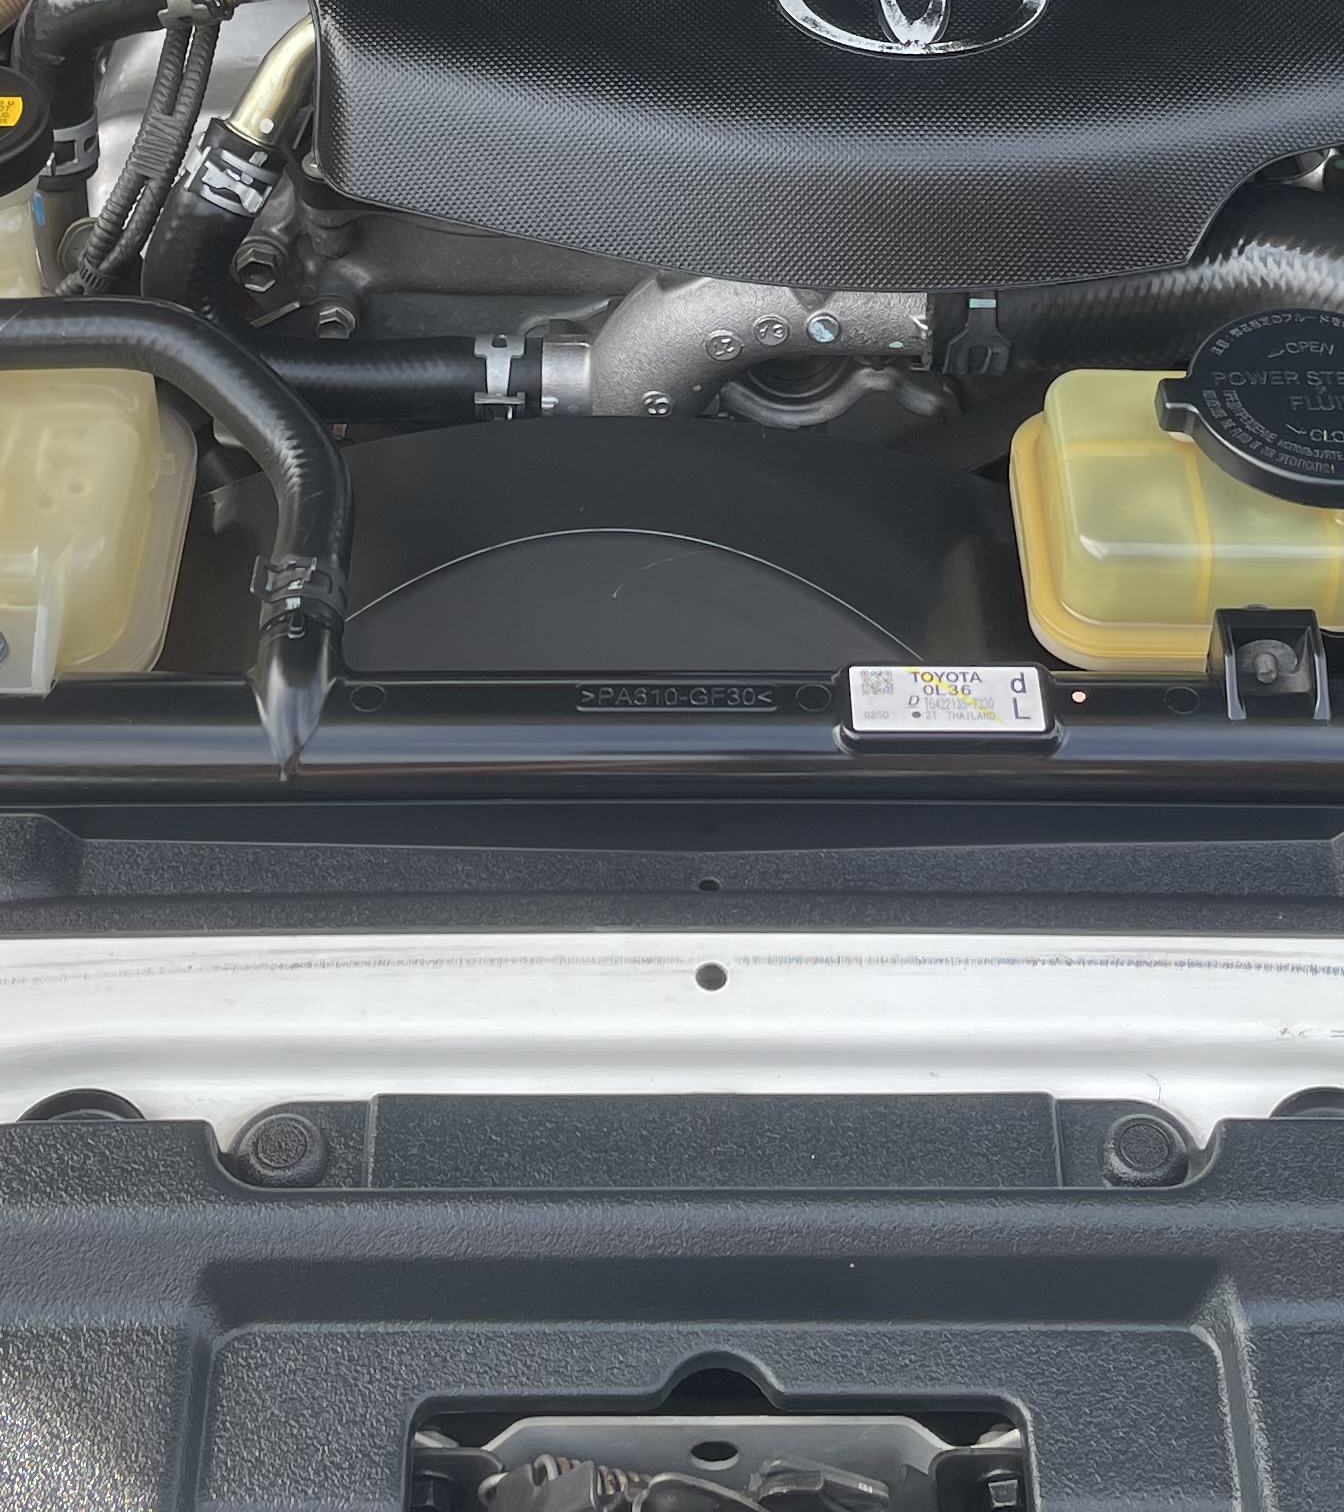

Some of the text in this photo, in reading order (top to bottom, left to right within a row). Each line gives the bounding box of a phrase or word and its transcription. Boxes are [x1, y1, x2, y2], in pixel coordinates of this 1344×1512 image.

[1285, 341, 1335, 356] OPEN
[1211, 371, 1301, 387] POWER
[911, 671, 983, 683] TOYOTA
[1010, 672, 1027, 694] d
[947, 710, 996, 721] THAILAND
[1012, 697, 1031, 721] L
